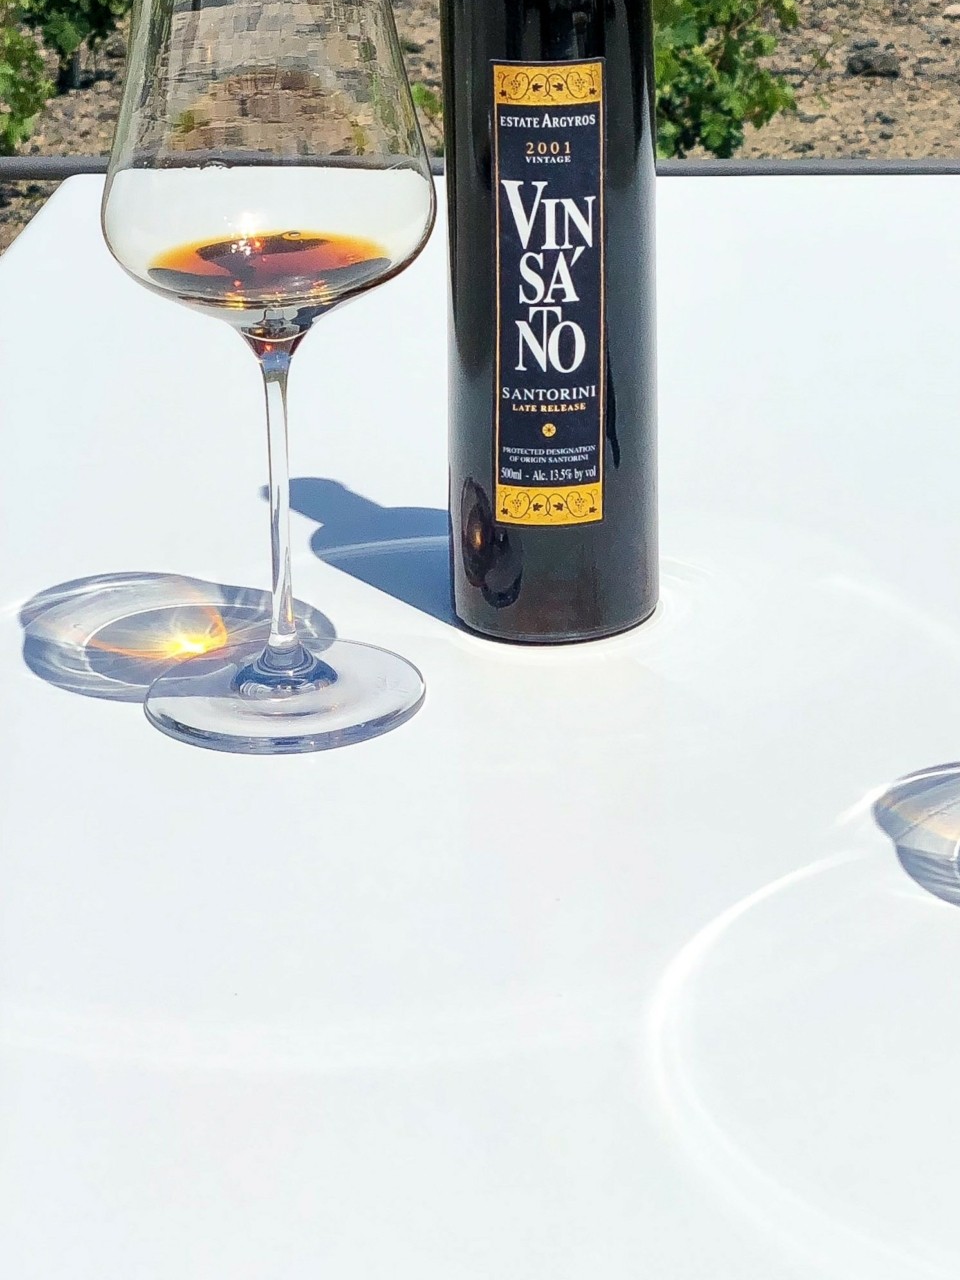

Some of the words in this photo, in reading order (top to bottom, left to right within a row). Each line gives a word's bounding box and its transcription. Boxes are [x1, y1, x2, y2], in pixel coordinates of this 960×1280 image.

[500, 115, 540, 128] ESTATE
[541, 113, 596, 128] ARGYROS
[525, 141, 571, 155] 2001
[525, 155, 571, 164] VINTAGE
[502, 385, 596, 401] SANTORINI
[512, 403, 537, 412] LATE
[540, 402, 587, 413] RELEASE
[502, 446, 545, 456] PROTECTED
[546, 445, 596, 456] DESIGNATION
[509, 455, 520, 463] OF
[520, 456, 546, 464] ORIGIN
[548, 454, 589, 463] SANTORINI
[501, 466, 522, 480] 500ml
[574, 467, 584, 482] by
[585, 465, 596, 477] vol
